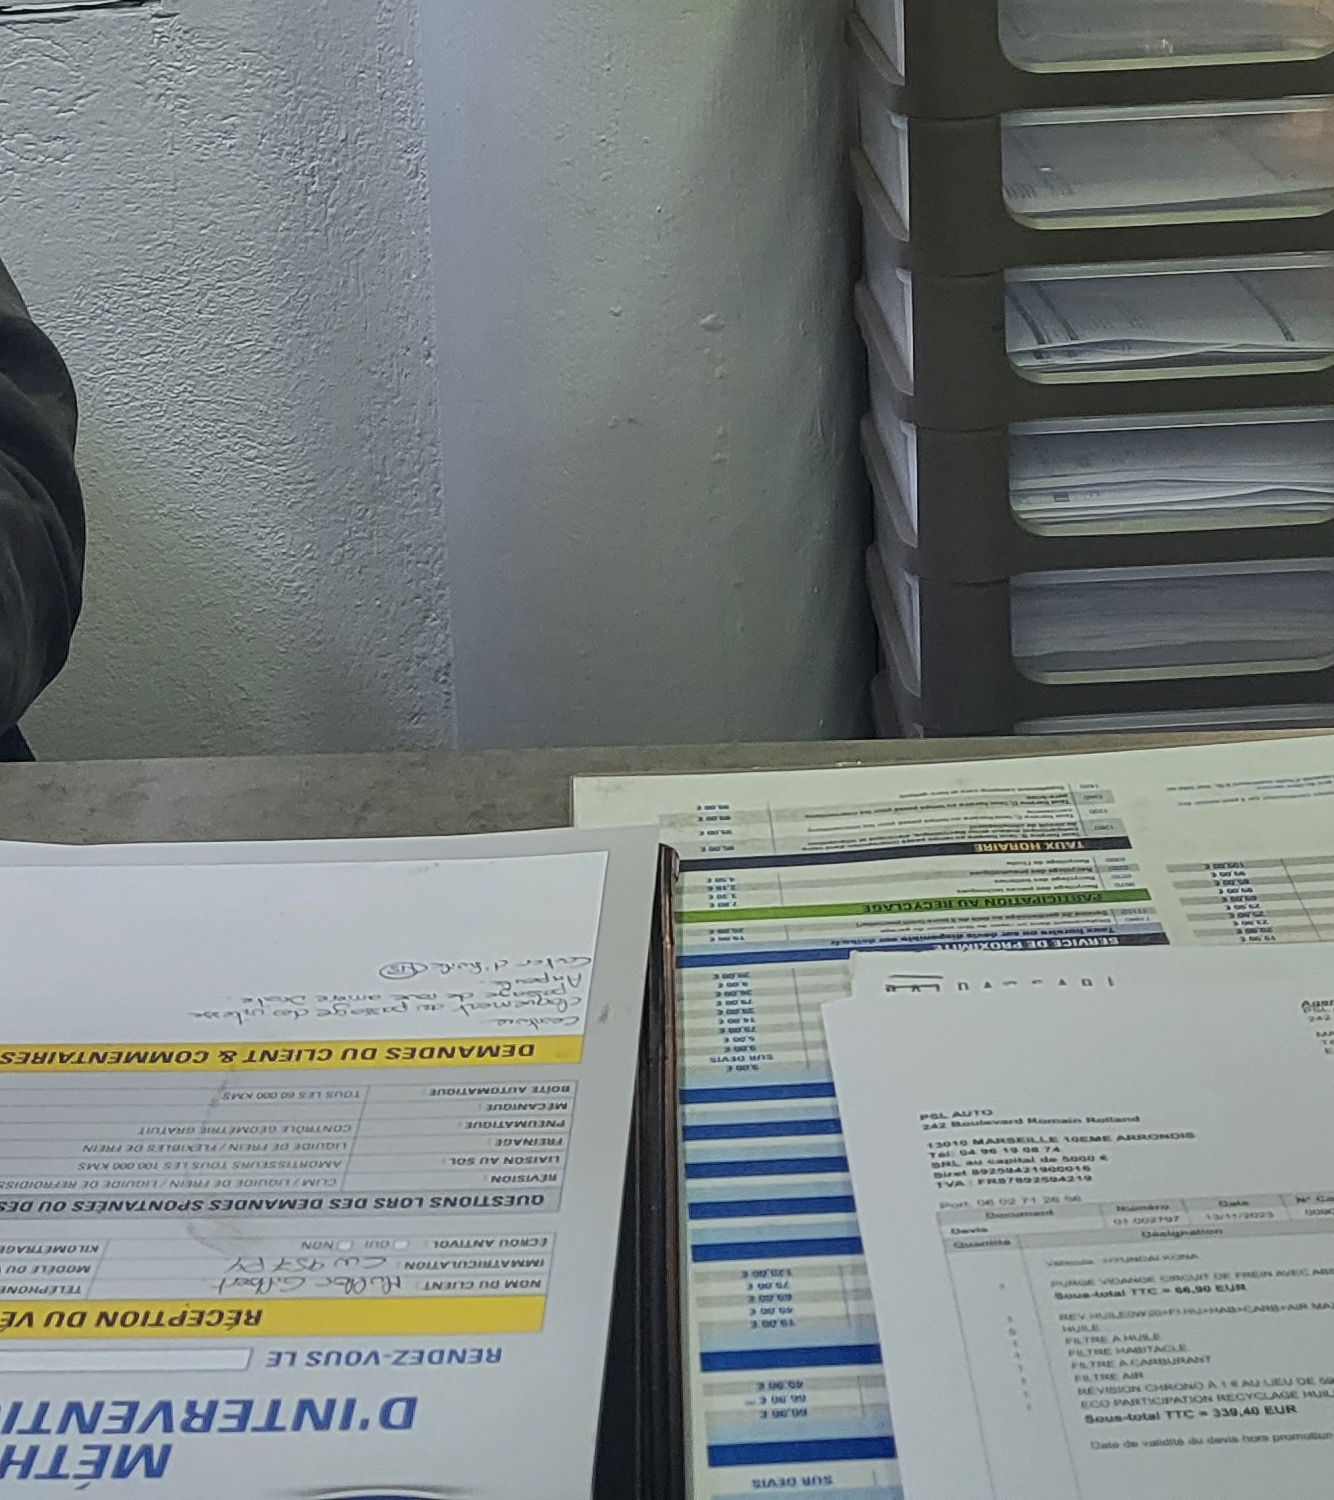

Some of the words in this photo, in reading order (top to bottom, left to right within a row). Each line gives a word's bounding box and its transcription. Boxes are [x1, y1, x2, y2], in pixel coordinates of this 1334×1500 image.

[973, 840, 1041, 854] HORAIRE
[1044, 839, 1084, 852] TAUX
[862, 899, 952, 914] RECYCLAGE
[955, 898, 981, 910] AU
[985, 892, 1102, 909] PARTICIPATION
[1028, 938, 1049, 949] DE
[1052, 935, 1119, 948] SERVICE
[217, 1049, 239, 1064] &
[243, 1048, 333, 1063] CLIENT
[340, 1047, 377, 1062] DU
[385, 1043, 535, 1061] DEMANDES
[428, 1086, 526, 1098] AUTOMATIQUE
[465, 1118, 566, 1130] PNEUMATIQUE
[494, 1137, 563, 1148] FREINAGE
[449, 1156, 475, 1167] SOL
[502, 1154, 560, 1165] LIAISON
[37, 1200, 66, 1213] OU
[71, 1199, 204, 1215] SPONTANÉES
[209, 1197, 323, 1212] DEMANDES
[328, 1196, 367, 1211] DES
[373, 1195, 424, 1210] LORS
[430, 1193, 545, 1210] QUESTIONS
[301, 1240, 334, 1251] NON
[432, 1238, 494, 1249] ANTIVOL
[403, 1258, 545, 1271] IMMATRICULATION
[422, 1279, 475, 1290] CLIENT
[504, 1278, 542, 1289] NOM
[44, 1310, 87, 1328] DU
[96, 1309, 263, 1331] RÉCEPTION
[265, 1350, 297, 1368] LE
[304, 1348, 503, 1367] RENDEZ-VOUS
[1165, 1408, 1196, 1421] TTC
[1264, 1403, 1298, 1416] EUR
